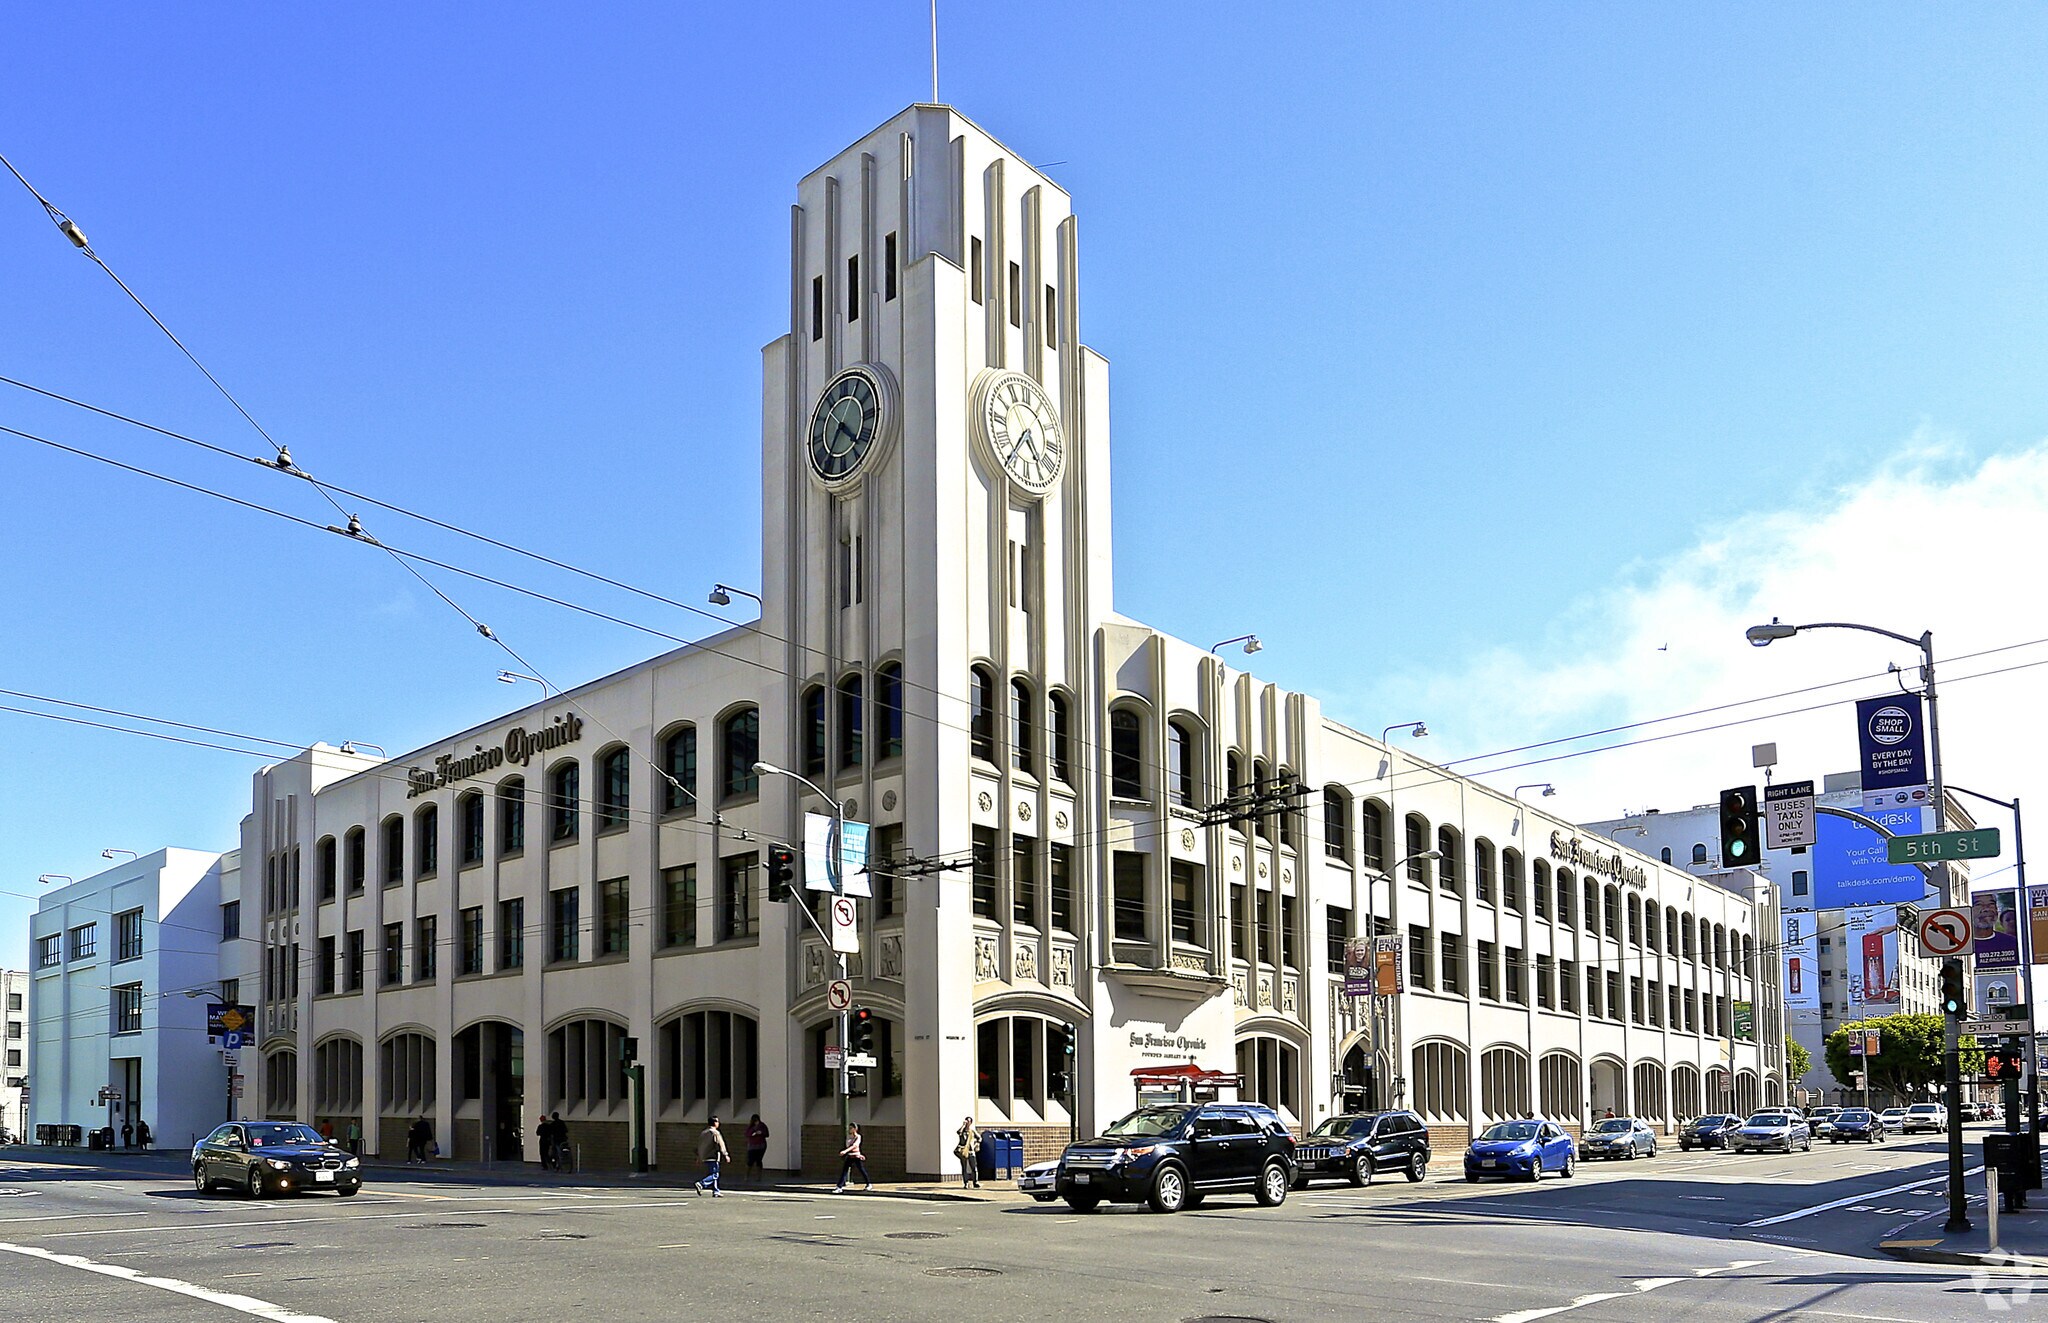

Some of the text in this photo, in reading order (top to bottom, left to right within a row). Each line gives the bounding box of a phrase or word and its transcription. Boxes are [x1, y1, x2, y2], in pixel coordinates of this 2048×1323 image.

[407, 711, 583, 799] San Francisco Chronicle
[1872, 749, 1912, 760] EVERY DAY
[1767, 786, 1810, 798] RIGHT LANE
[1774, 800, 1805, 811] BUSES
[1777, 810, 1804, 821] TAXIS
[1852, 812, 1912, 829] takdesk
[1779, 820, 1802, 830] ONLY
[1907, 838, 1979, 856] 5th St
[1550, 830, 1647, 891] San Francisco Chronicle
[1851, 858, 1869, 866] with
[1838, 876, 1916, 887] talkdesk.com/demo
[1379, 943, 1402, 952] END
[1968, 1024, 1991, 1032] 5TH
[1129, 1032, 1206, 1051] San Francisco Chronicle
[2012, 1058, 2020, 1072] 4
